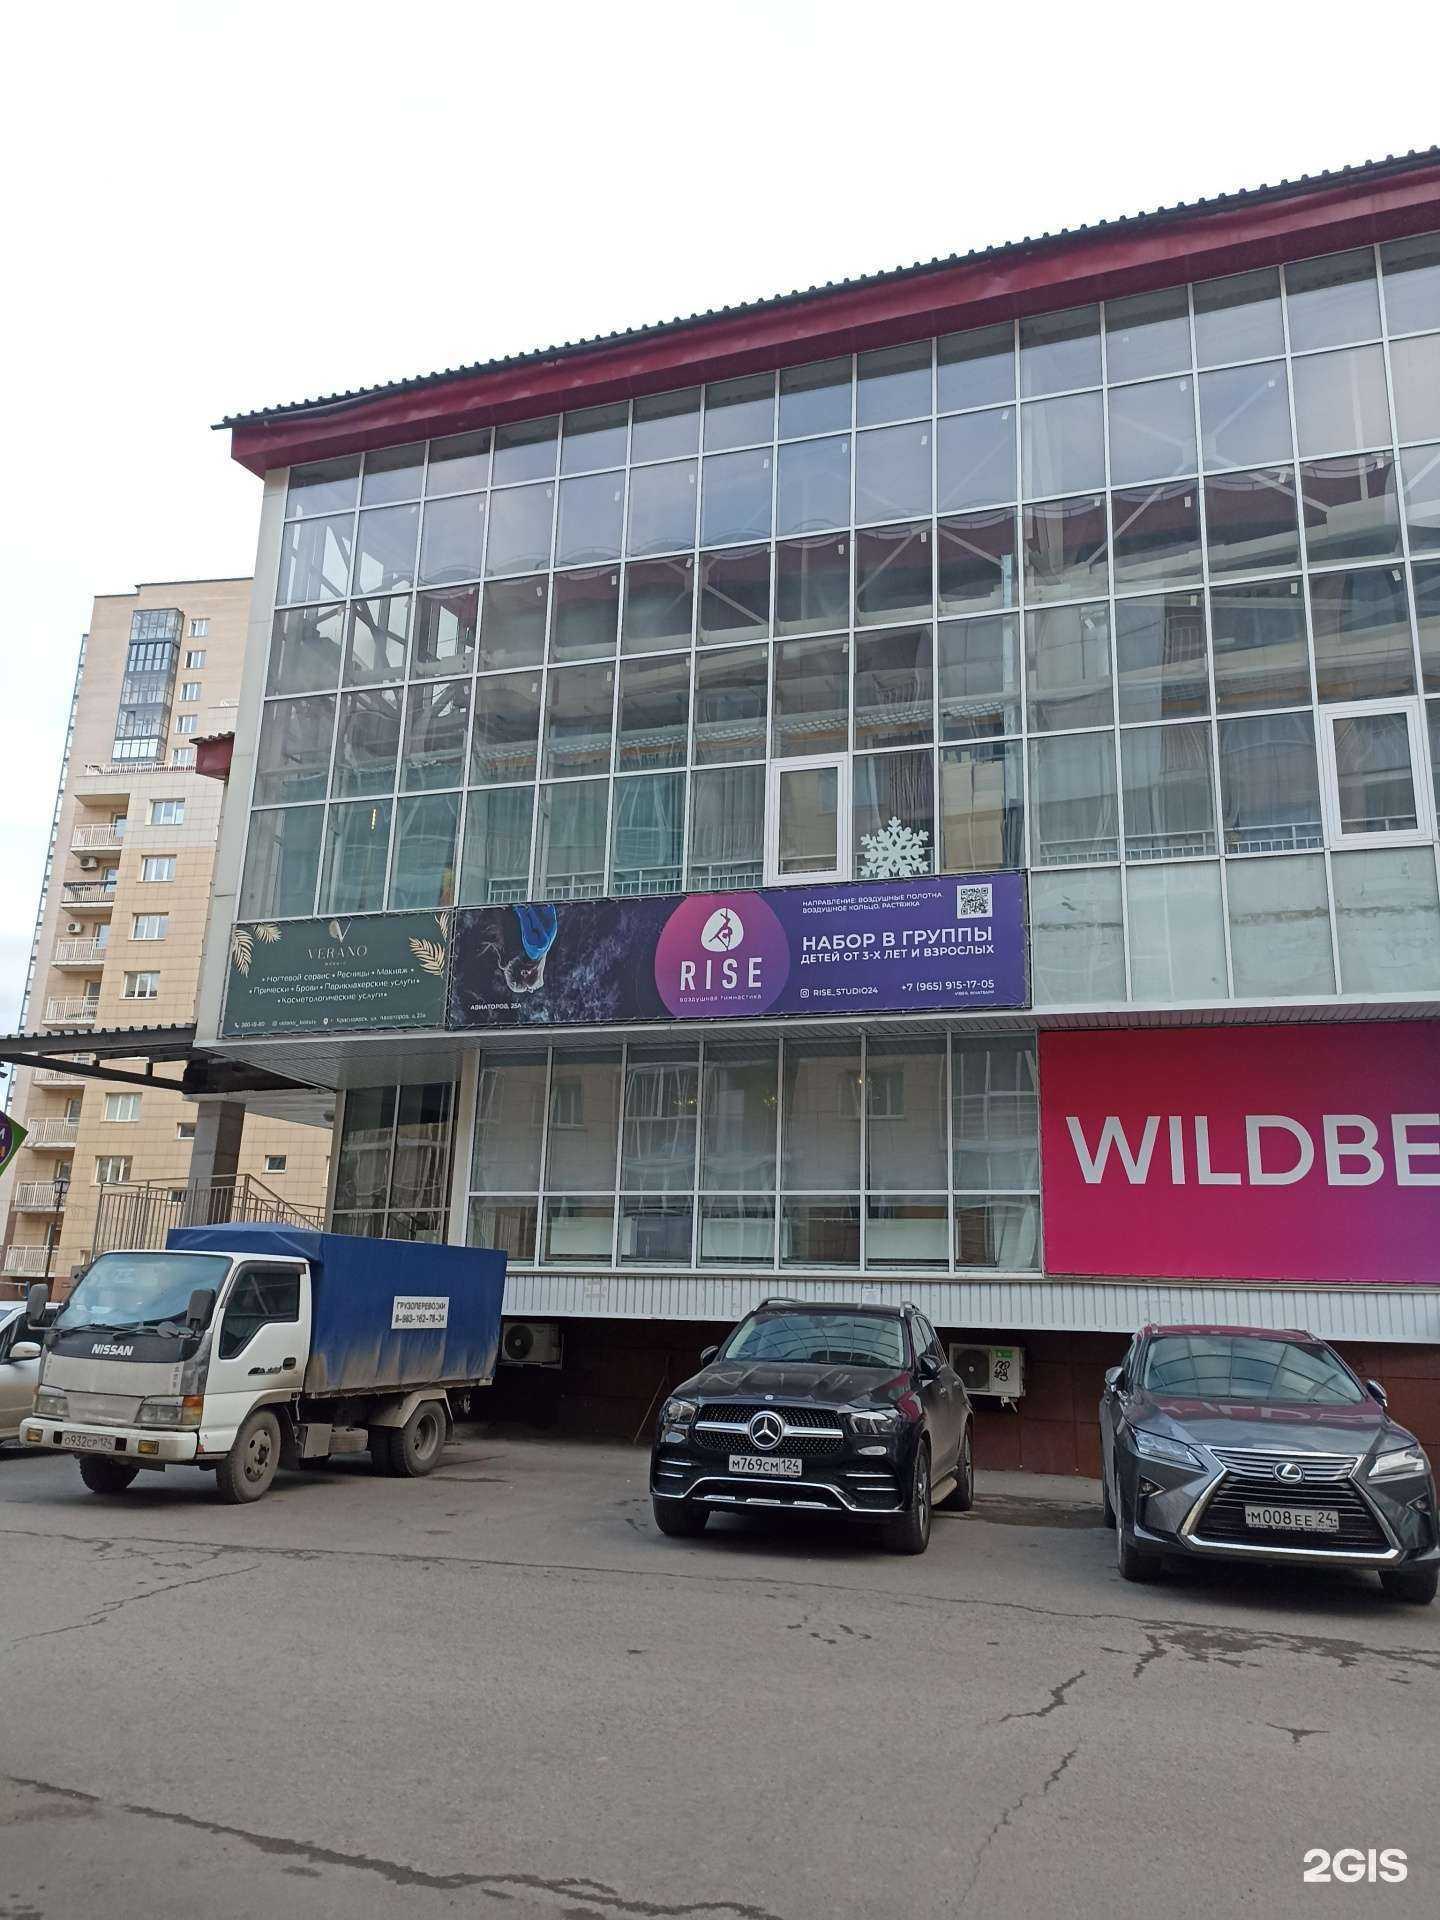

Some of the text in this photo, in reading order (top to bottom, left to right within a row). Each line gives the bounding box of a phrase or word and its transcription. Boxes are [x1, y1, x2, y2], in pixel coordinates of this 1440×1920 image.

[802, 926, 993, 951] НАБОР В ГРУППЫ
[306, 943, 369, 961] VERANO
[800, 944, 995, 965] ДЕТЕЙ ОТ 3-Х ЛЕТ И ВЗРОСЛЫХ
[680, 956, 763, 991] RISE
[915, 981, 943, 993] (965)
[944, 979, 996, 991] 915-17-05
[1065, 1113, 1440, 1186] WILDBE
[91, 1343, 134, 1356] NISSAN
